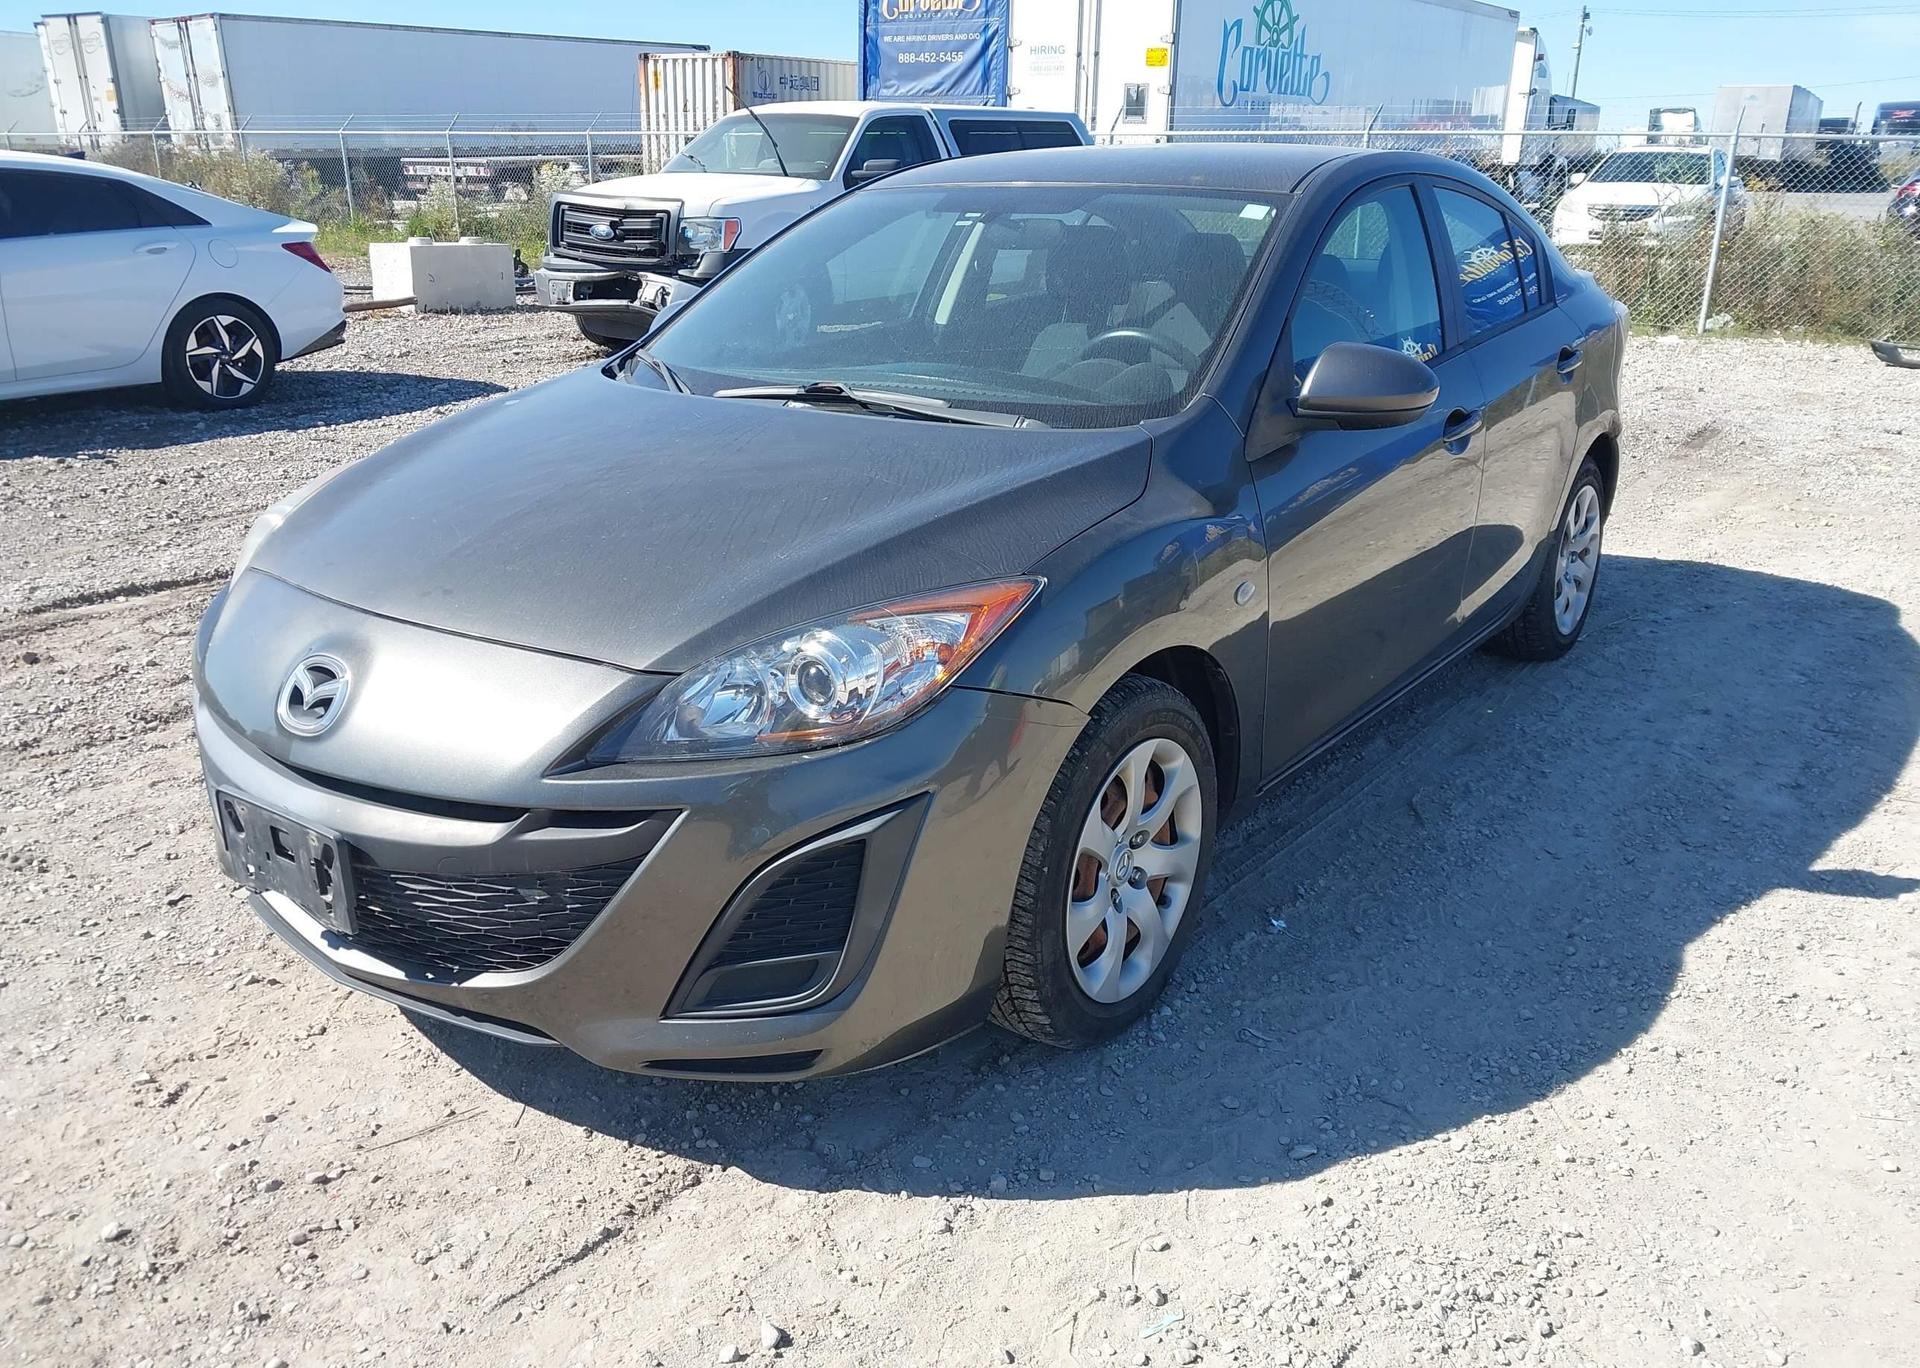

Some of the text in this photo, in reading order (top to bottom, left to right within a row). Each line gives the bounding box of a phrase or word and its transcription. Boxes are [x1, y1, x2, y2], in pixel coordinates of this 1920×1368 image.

[928, 33, 954, 41] DRIVERS
[1030, 45, 1066, 55] HIRING
[898, 52, 964, 63] 888-452-5455
